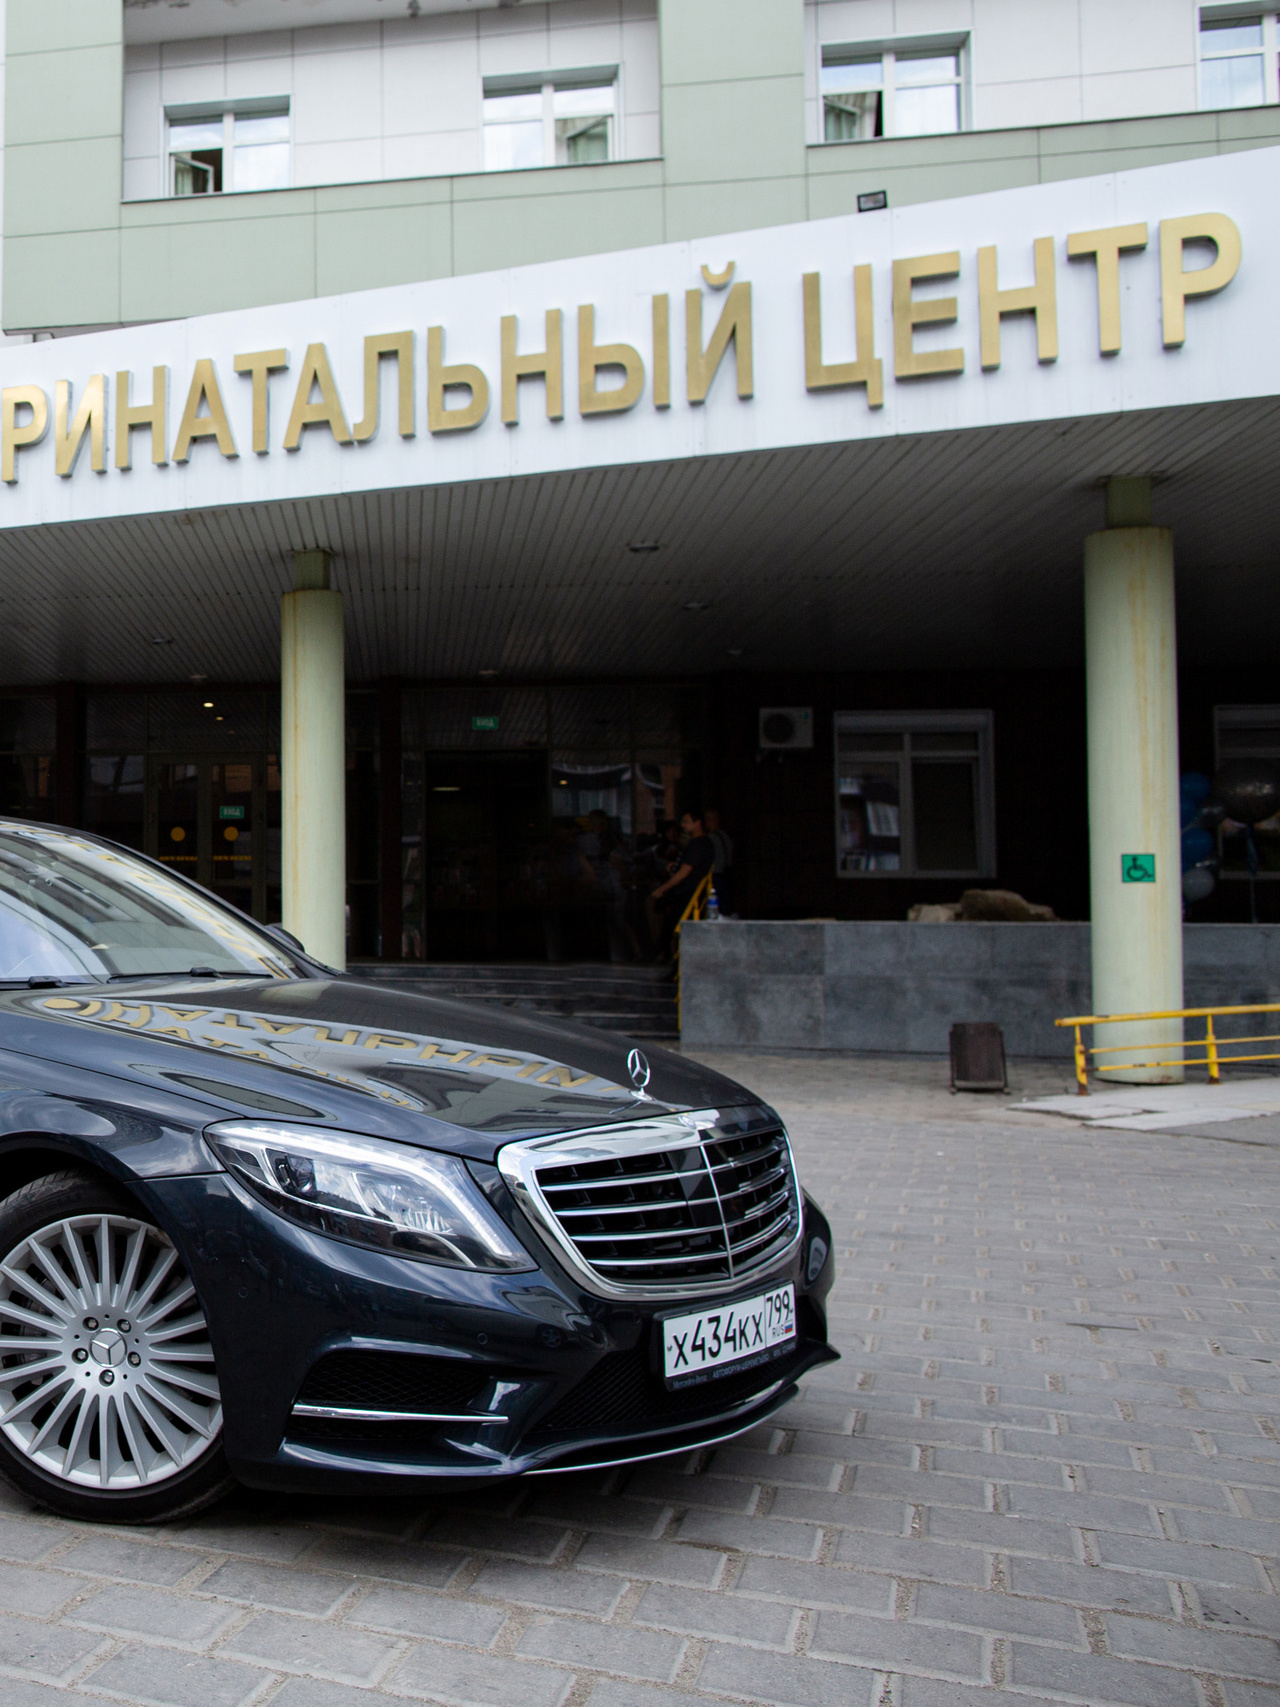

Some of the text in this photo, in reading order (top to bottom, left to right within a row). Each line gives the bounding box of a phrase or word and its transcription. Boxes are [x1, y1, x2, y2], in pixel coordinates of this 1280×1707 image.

[802, 212, 1242, 411] ЦЕНТР
[673, 1290, 791, 1369] Х434КХ 799
[772, 1324, 785, 1337] RUS
